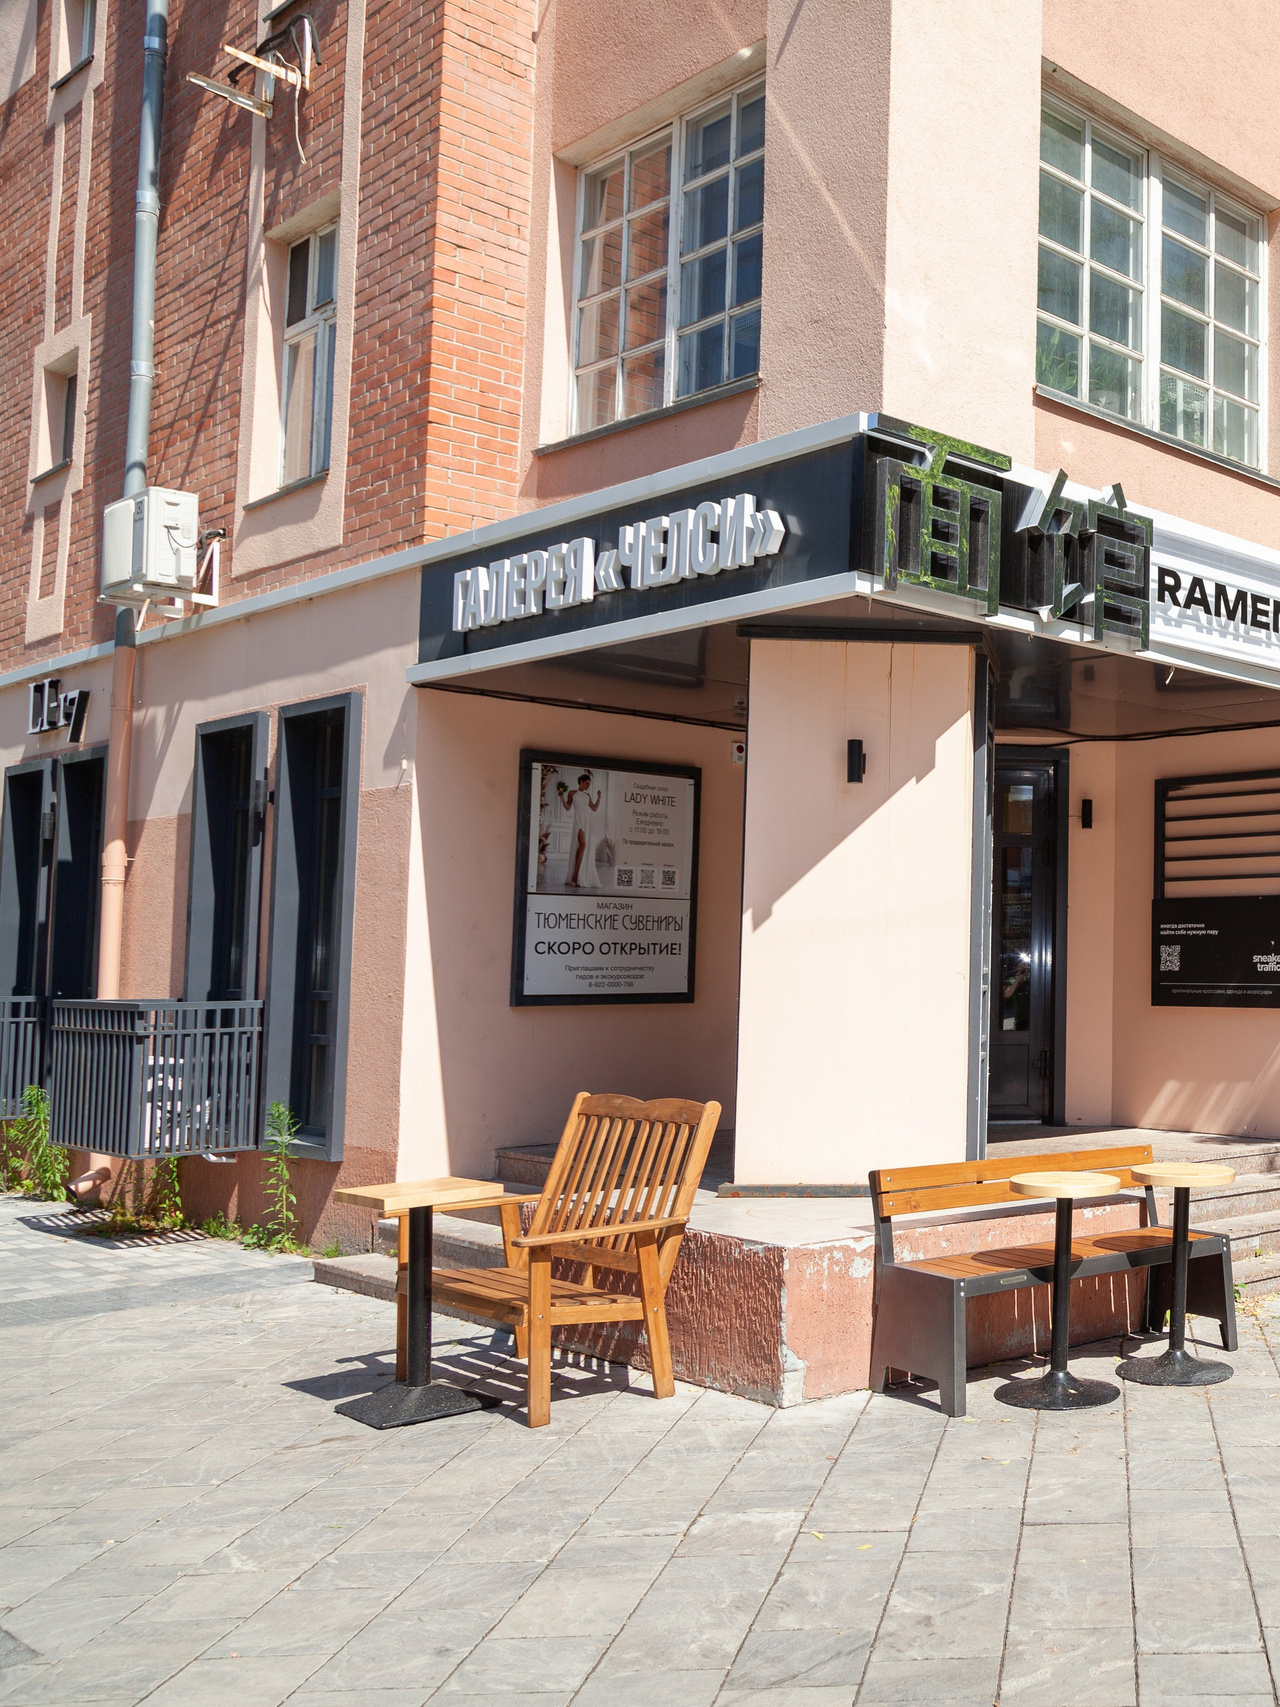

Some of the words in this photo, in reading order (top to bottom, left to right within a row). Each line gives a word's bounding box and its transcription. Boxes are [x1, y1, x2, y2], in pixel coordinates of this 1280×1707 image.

[452, 537, 596, 632] ГАЛЕРЕЯ
[595, 493, 785, 592] «ЧЕЛСИ»
[624, 792, 648, 804] LADY
[650, 795, 676, 807] WHITE
[650, 811, 669, 819] работы
[636, 818, 664, 827] Ежедневно
[597, 902, 633, 910] МАГАЗИН
[534, 912, 620, 931] ТЮМЕНСКИЕ
[622, 914, 684, 931] СУВЕНИРЫ
[534, 941, 595, 955] СКОРО
[599, 942, 682, 955] ОТКРЫТИЕ!
[610, 965, 655, 973] сотрудничеству
[1257, 961, 1280, 972] traffic
